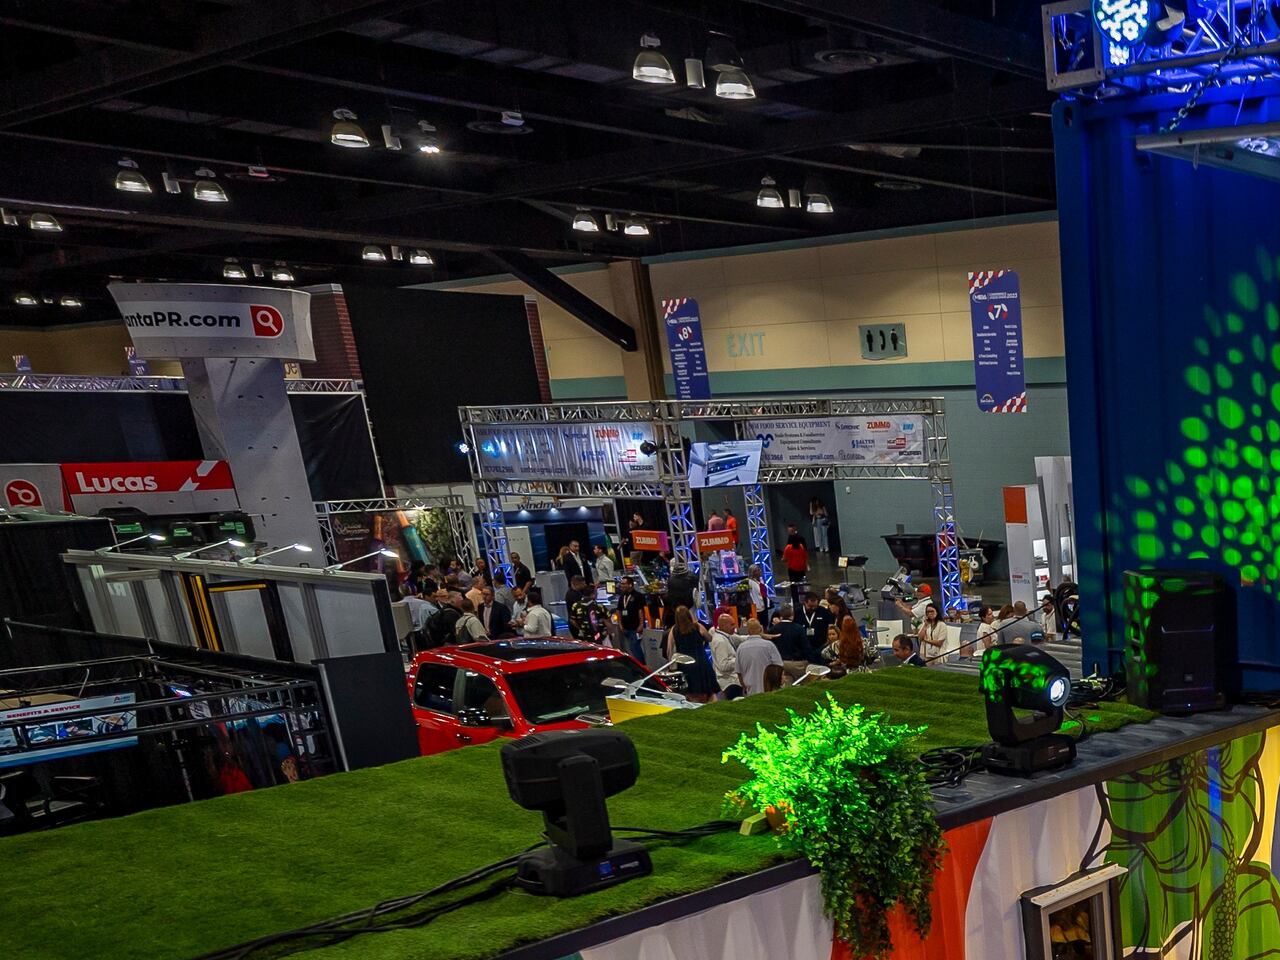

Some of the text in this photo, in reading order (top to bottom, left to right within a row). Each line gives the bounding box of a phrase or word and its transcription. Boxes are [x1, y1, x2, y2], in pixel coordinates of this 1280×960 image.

[993, 304, 1002, 318] 7
[681, 327, 689, 340] 8
[726, 332, 766, 358] EXIT
[775, 421, 797, 429] SERVICE
[798, 421, 831, 429] EQUIPMENT
[866, 421, 891, 430] ZUMMO
[74, 471, 159, 492] Lucas
[516, 500, 565, 511] windmar
[635, 536, 658, 545] ZUMMO
[700, 536, 730, 546] ZUMMO
[6, 709, 42, 719] BENEFITS
[50, 704, 81, 714] SERVICE
